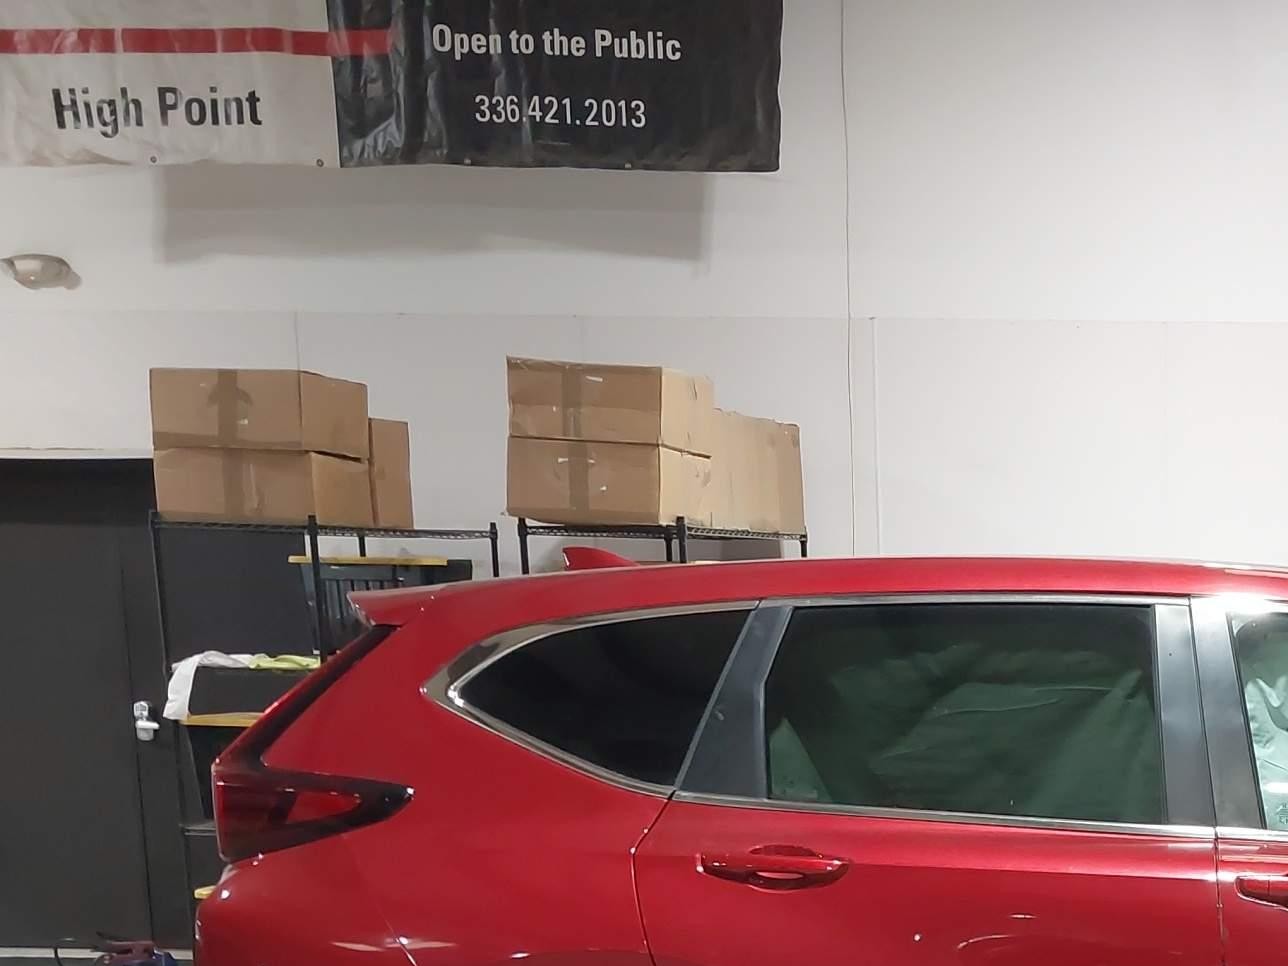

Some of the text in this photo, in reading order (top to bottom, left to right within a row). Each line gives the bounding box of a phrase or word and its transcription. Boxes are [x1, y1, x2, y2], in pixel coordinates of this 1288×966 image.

[432, 24, 682, 61] Open to the Public
[51, 86, 262, 138] High Point
[474, 95, 647, 128] 336.421.2013
